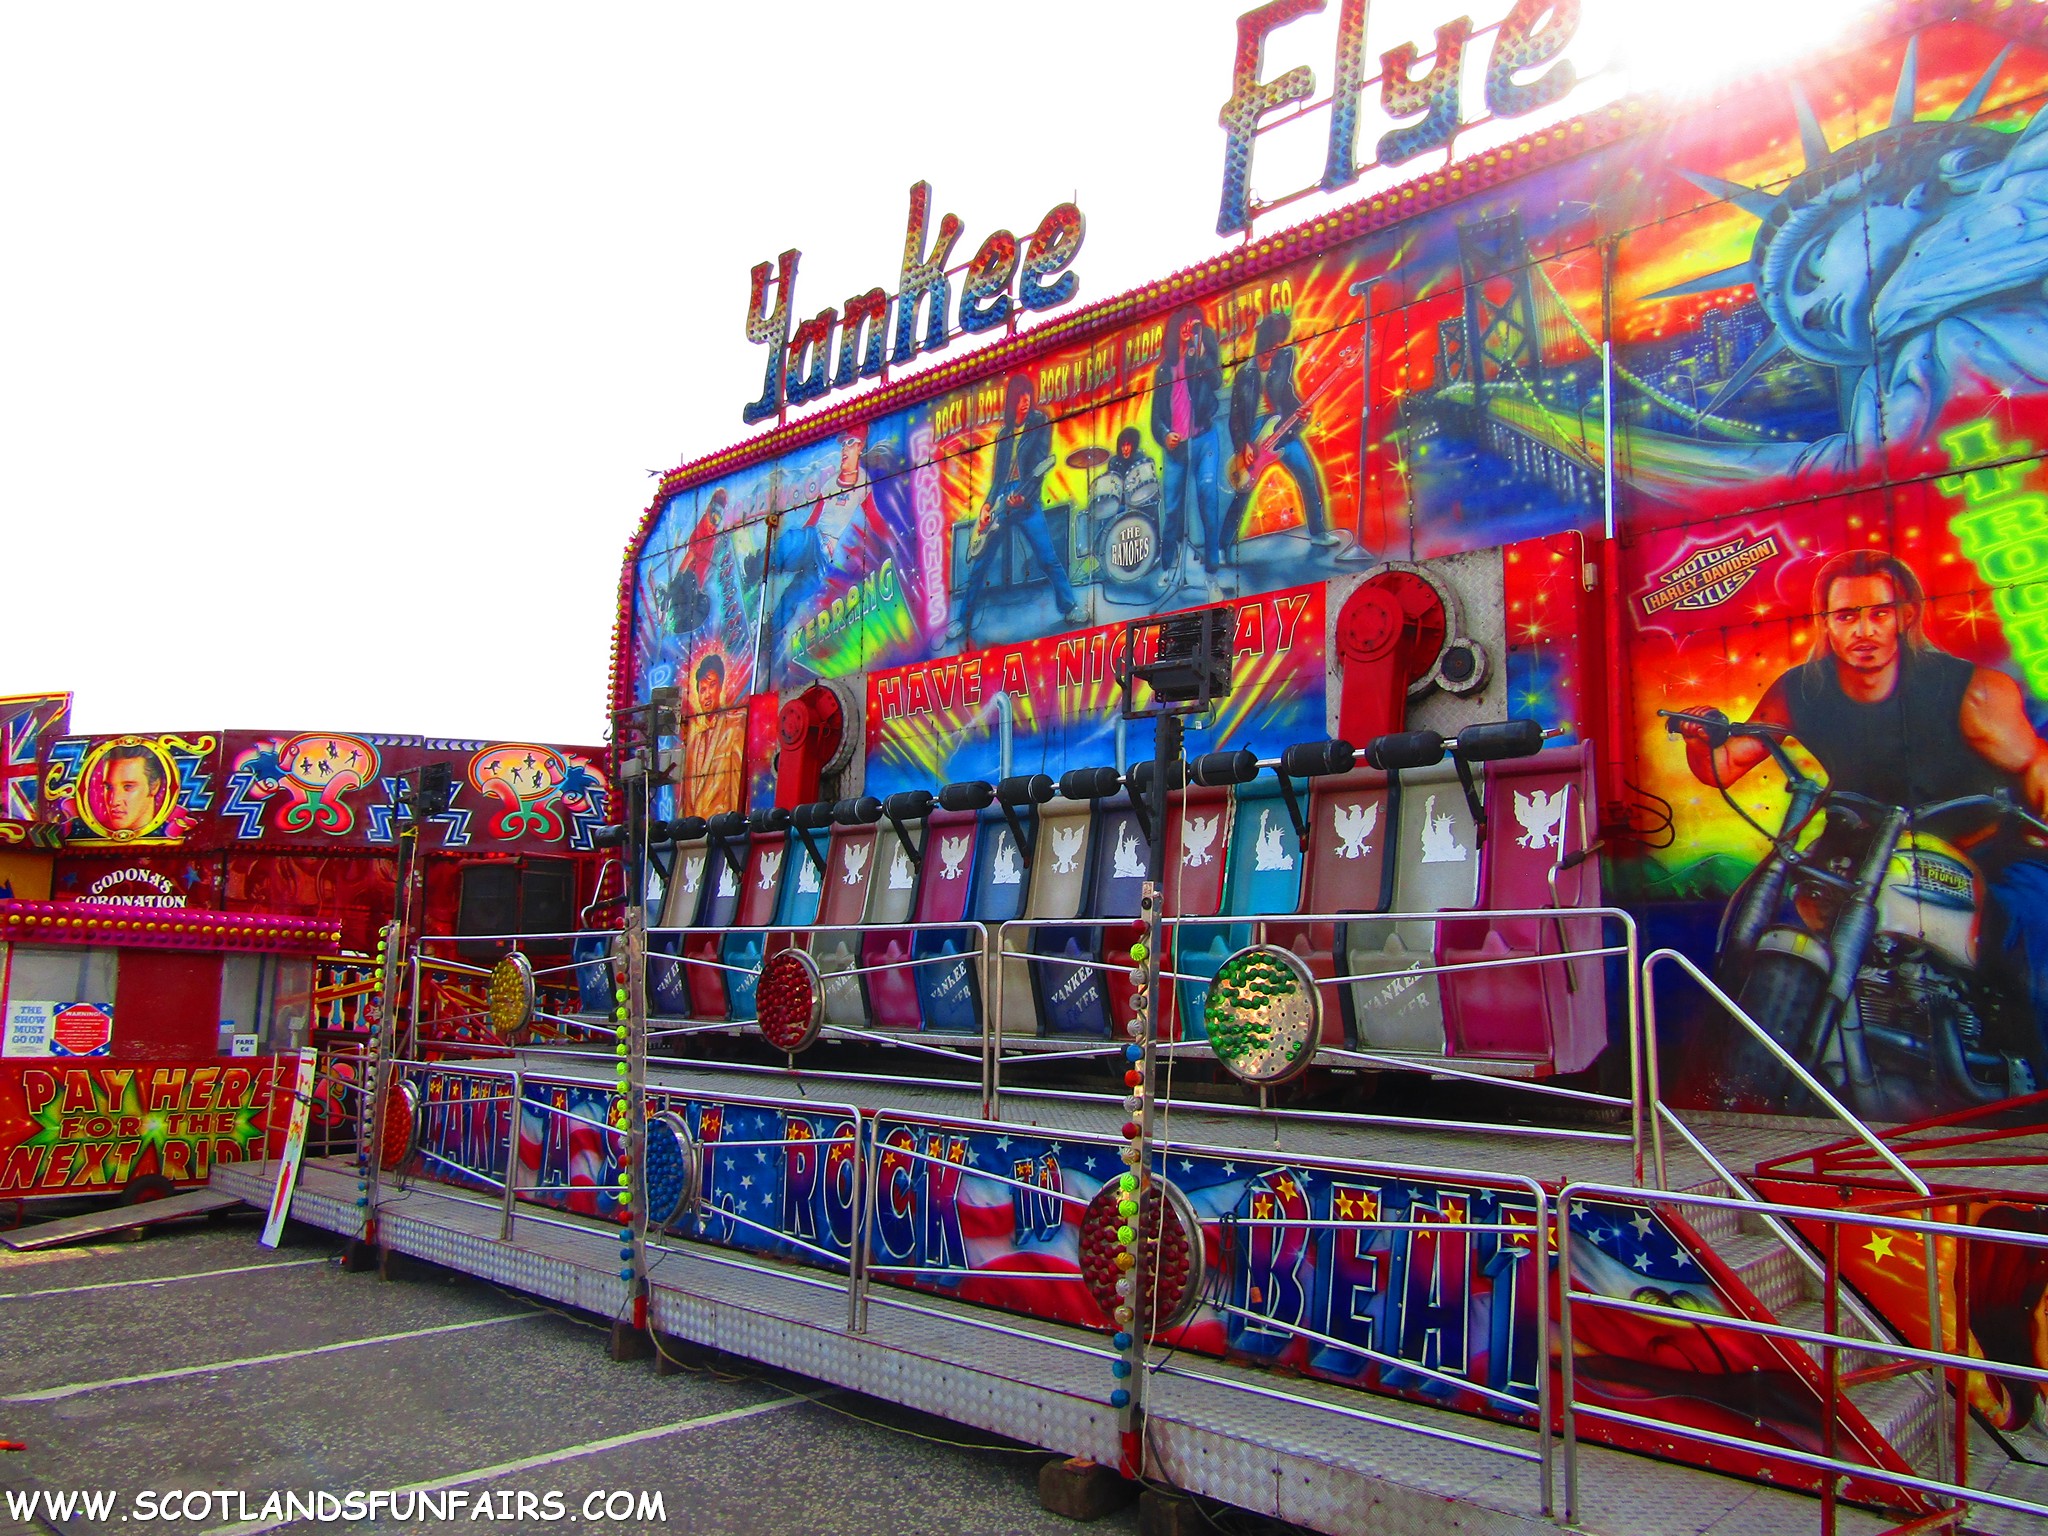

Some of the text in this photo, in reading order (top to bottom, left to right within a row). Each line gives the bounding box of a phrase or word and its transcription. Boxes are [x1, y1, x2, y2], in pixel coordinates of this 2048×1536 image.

[743, 181, 1086, 424] Yankee
[1270, 279, 1293, 317] GO
[1037, 364, 1070, 404] ROCK
[1085, 344, 1117, 392] ROLL
[935, 399, 963, 443] ROCK
[1119, 526, 1142, 541] THE
[1648, 542, 1771, 608] HARLEY-DAVIDSON
[1673, 544, 1740, 582] MOTOR
[1682, 571, 1747, 607] CYCLES
[791, 557, 895, 660] KERRANG
[877, 657, 984, 722] HAVE
[1001, 652, 1030, 700] A
[1229, 592, 1311, 661] AY
[91, 867, 174, 895] GODONA'S
[74, 894, 188, 908] CORONATION
[930, 961, 967, 998] YANKEE
[1050, 966, 1093, 1003] YANKEE
[13, 1015, 47, 1025] SHOW
[20, 1005, 43, 1015] THE
[11, 1035, 46, 1044] GO ON
[13, 1025, 46, 1035] MUST
[23, 1066, 287, 1115] PAY HERE
[58, 1112, 237, 1140] FOR THE
[543, 1086, 572, 1192] A
[0, 1139, 143, 1190] NEXT
[782, 1114, 971, 1271] ROCK
[1011, 1151, 1065, 1238] TO
[1243, 1164, 1559, 1391] BEAT
